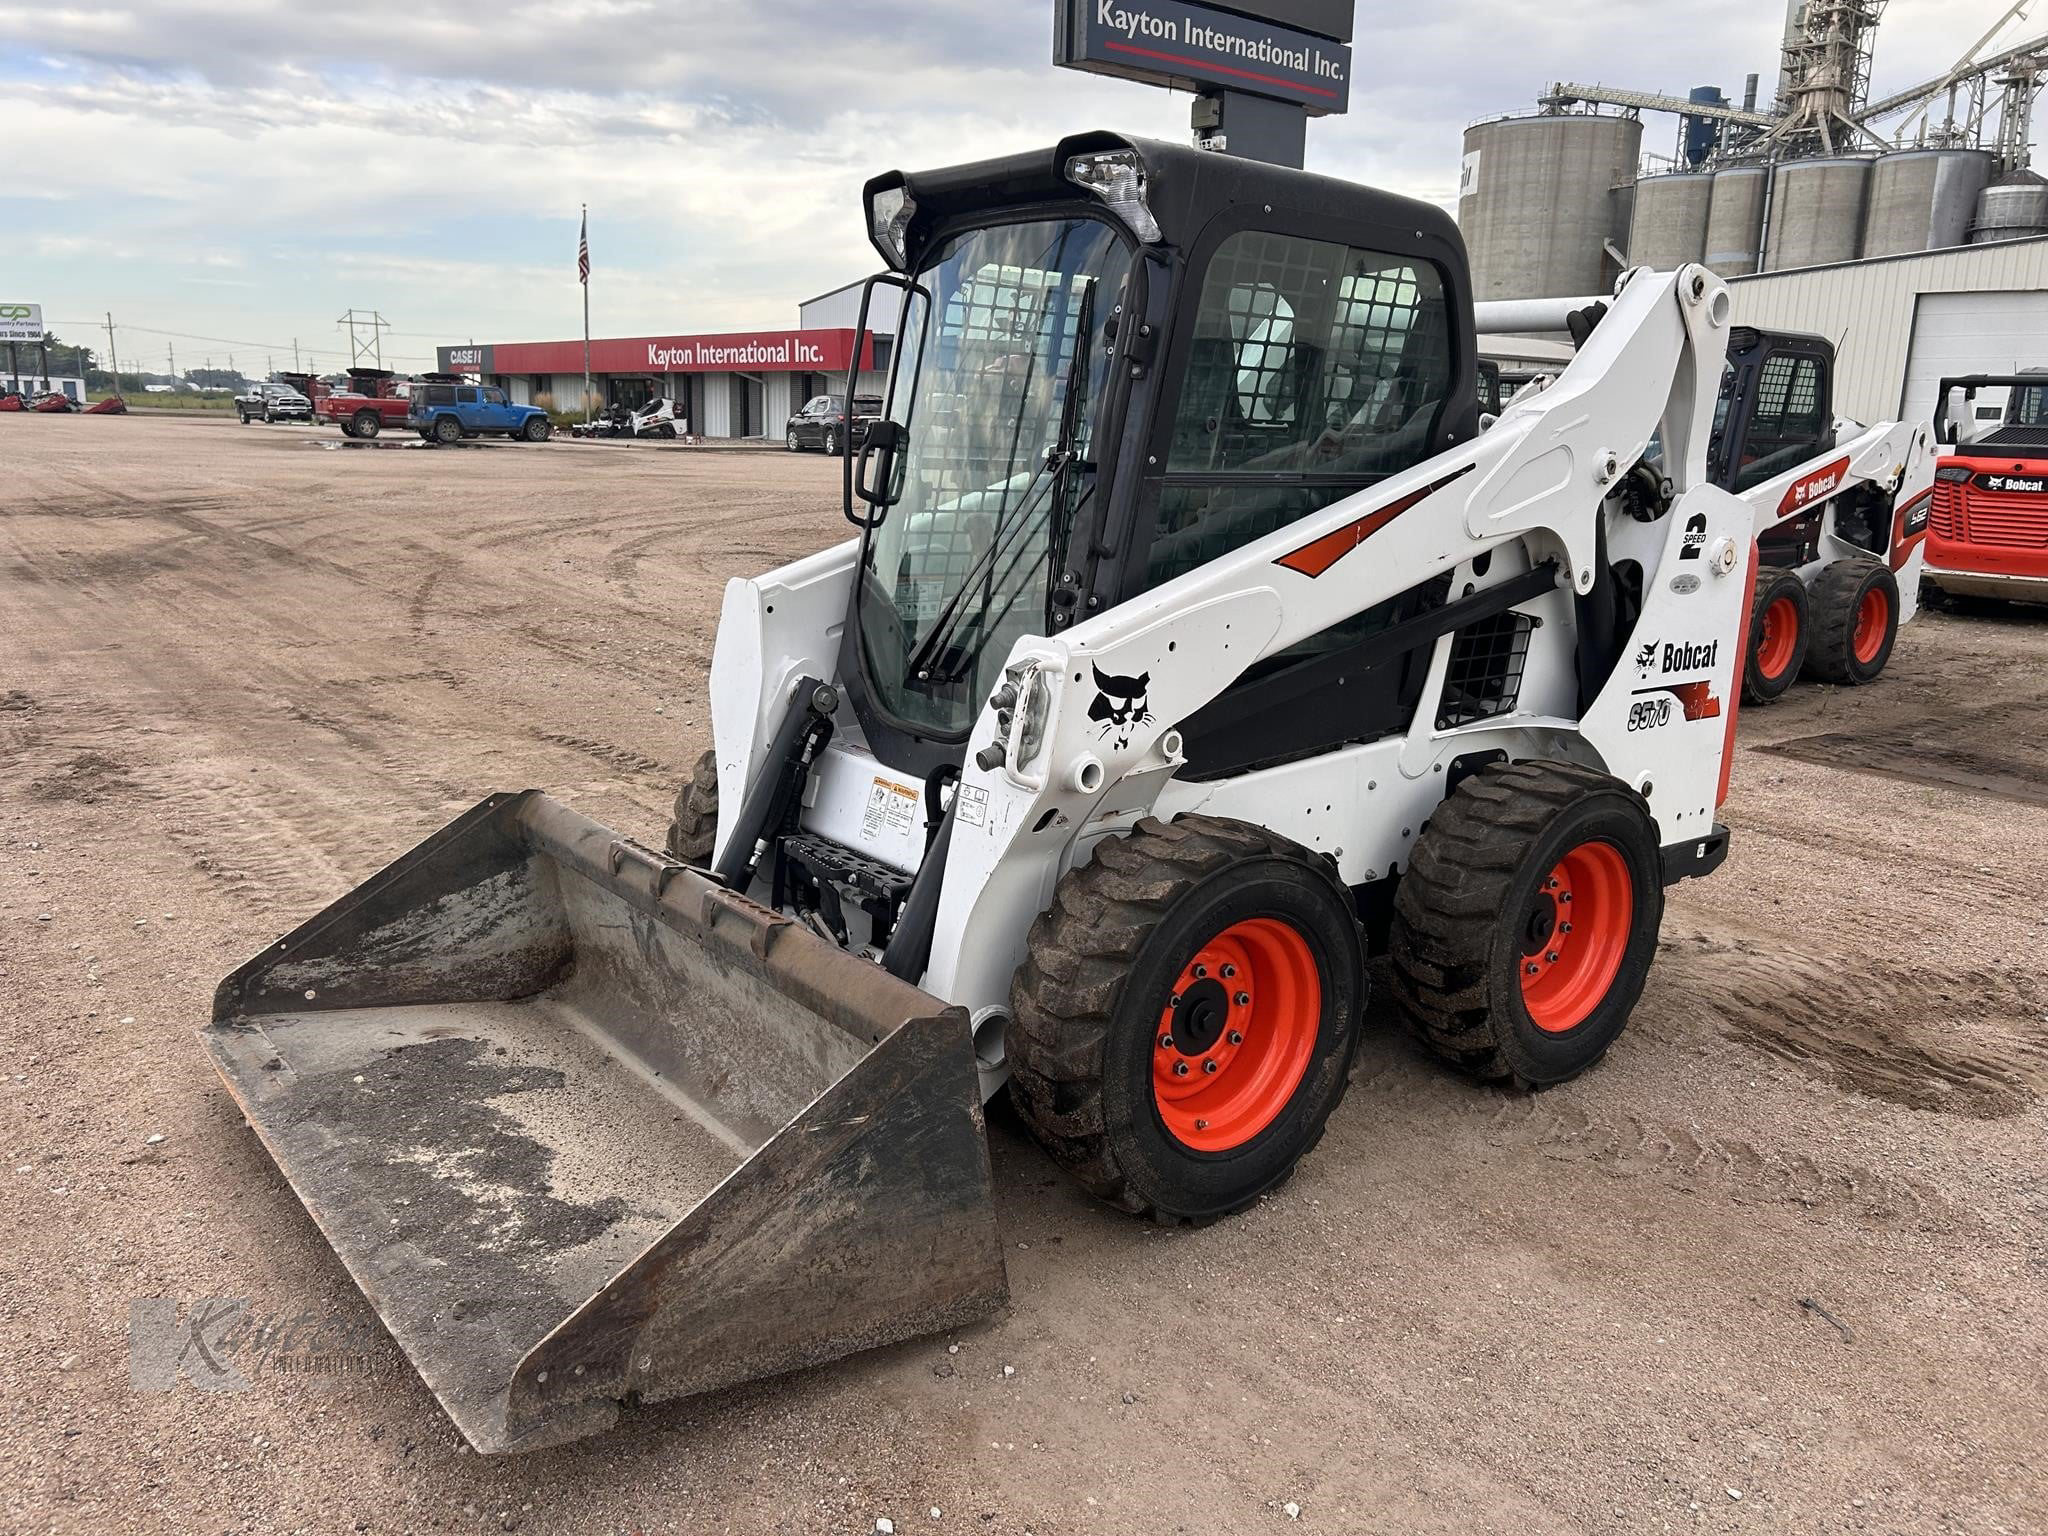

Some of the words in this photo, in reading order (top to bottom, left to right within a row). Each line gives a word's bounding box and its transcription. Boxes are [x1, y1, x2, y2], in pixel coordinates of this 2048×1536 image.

[1097, 0, 1177, 40] Kayton
[1184, 17, 1309, 72] International
[1314, 50, 1344, 80] Inc.
[648, 344, 693, 371] Kayton
[696, 339, 789, 364] International
[794, 339, 824, 363] Inc.
[1808, 472, 1836, 500] Bobcat
[2005, 478, 2044, 492] Bobcat
[1682, 534, 1707, 544] SPEED
[1661, 639, 1718, 674] Bobcat
